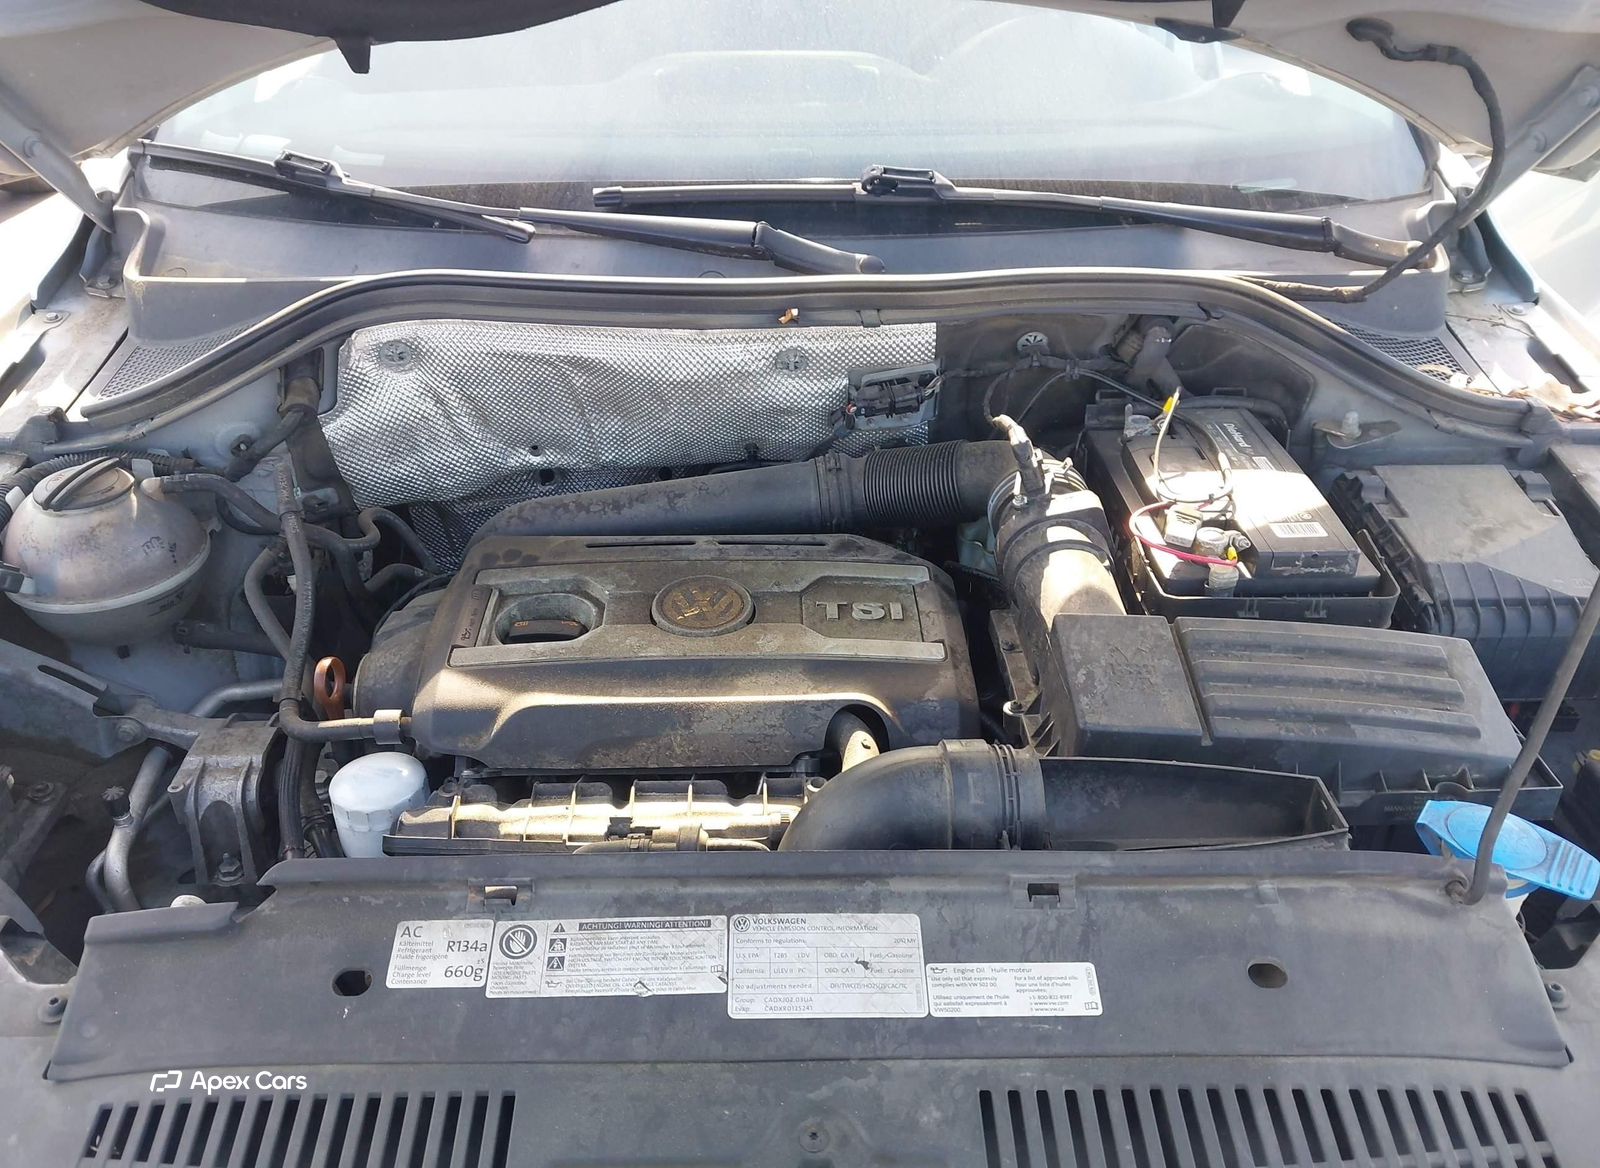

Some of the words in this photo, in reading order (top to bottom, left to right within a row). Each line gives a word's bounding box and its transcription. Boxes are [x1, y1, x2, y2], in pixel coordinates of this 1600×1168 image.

[1223, 423, 1252, 448] DieHard
[815, 601, 904, 622] TSI
[623, 921, 663, 929] WARNING!
[664, 920, 709, 928] ATTENTION!
[400, 926, 423, 938] AC
[446, 940, 488, 952] R134a
[392, 971, 415, 979] Charge
[444, 965, 484, 981] 660g
